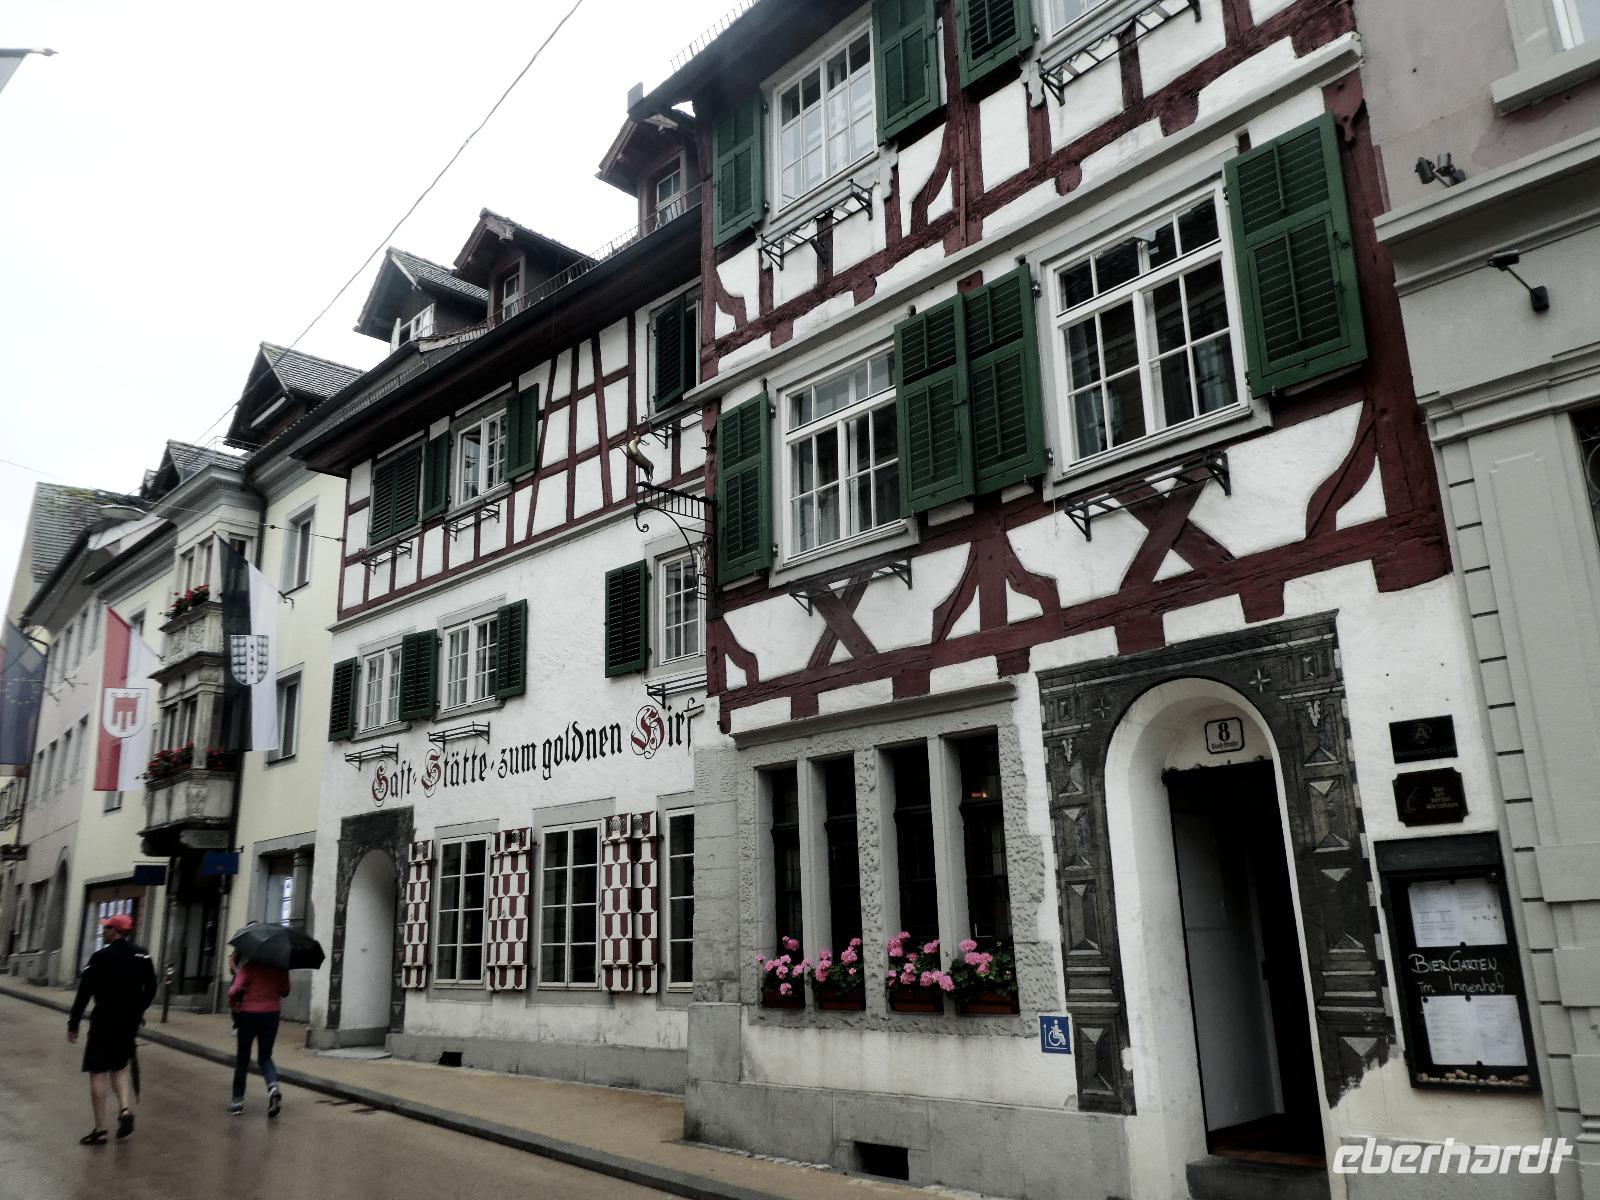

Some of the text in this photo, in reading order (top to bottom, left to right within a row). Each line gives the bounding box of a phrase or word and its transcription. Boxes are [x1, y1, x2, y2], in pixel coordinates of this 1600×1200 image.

[1218, 722, 1230, 741] 8
[498, 741, 537, 779] zum
[542, 720, 623, 781] goldnen
[1416, 972, 1505, 995] im Innenhof
